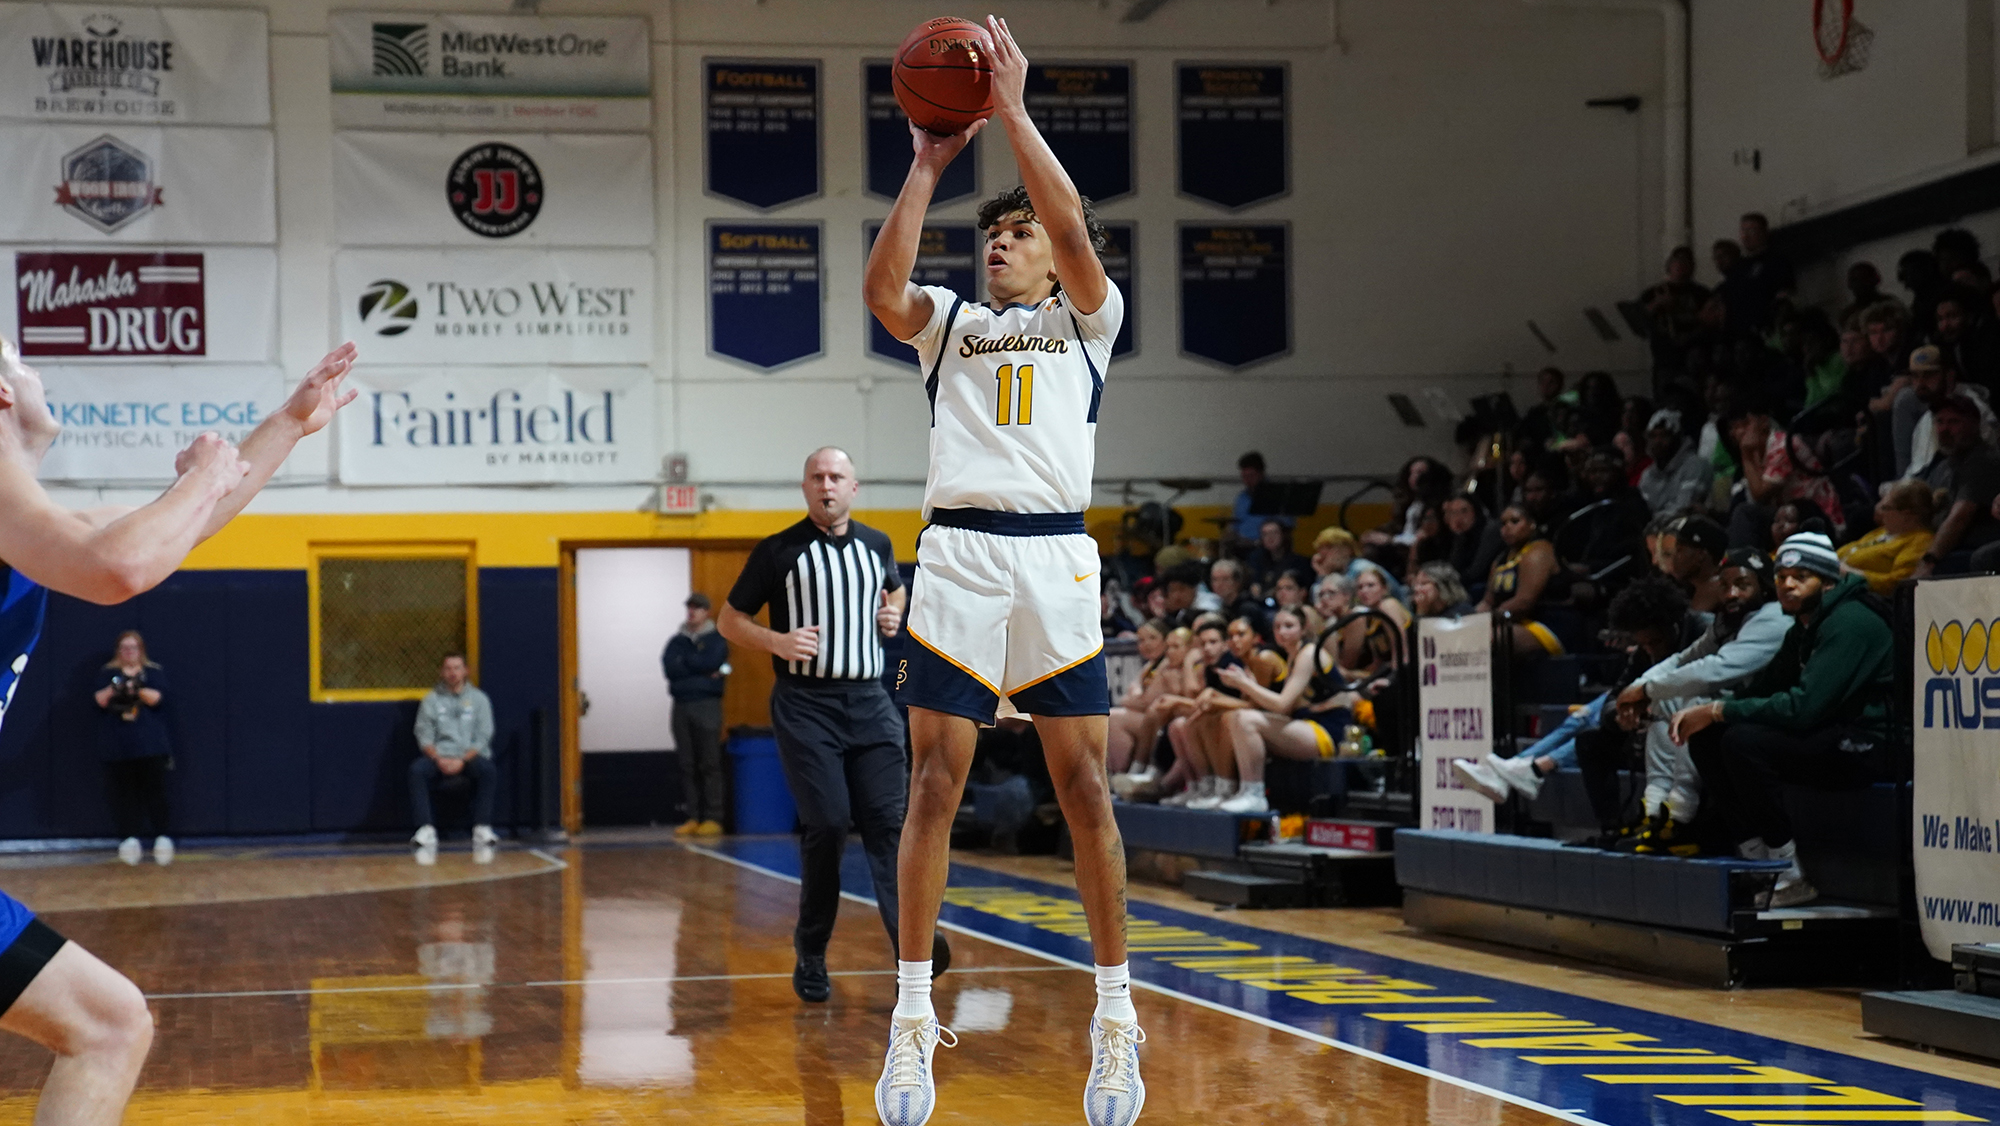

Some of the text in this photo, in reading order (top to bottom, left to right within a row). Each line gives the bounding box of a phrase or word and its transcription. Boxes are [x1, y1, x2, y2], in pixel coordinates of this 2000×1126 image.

[32, 36, 174, 71] WAREHOUSE
[441, 31, 609, 57] MidWestOne
[716, 70, 807, 88] FOOTBALL
[472, 168, 520, 215] JJ
[719, 232, 810, 250] SOFTBALL
[20, 258, 138, 313] Mahaska
[88, 307, 201, 352] DRUG
[435, 322, 630, 337] MONEY SIMPLIFIED
[959, 334, 1068, 358] Statesmen
[996, 364, 1034, 426] 11
[61, 402, 262, 427] KINETIC EDGE
[371, 388, 616, 447] Fairfield
[62, 430, 164, 448] PHYSICAL
[486, 451, 619, 465] BY MARRIOTT
[666, 486, 696, 509] EXIT
[1428, 708, 1484, 740] OUR TEAM
[1922, 815, 1949, 849] We
[1954, 816, 1992, 853] Make
[1152, 956, 1496, 1004] PENN
[1363, 1011, 1991, 1126] ILLIAM
